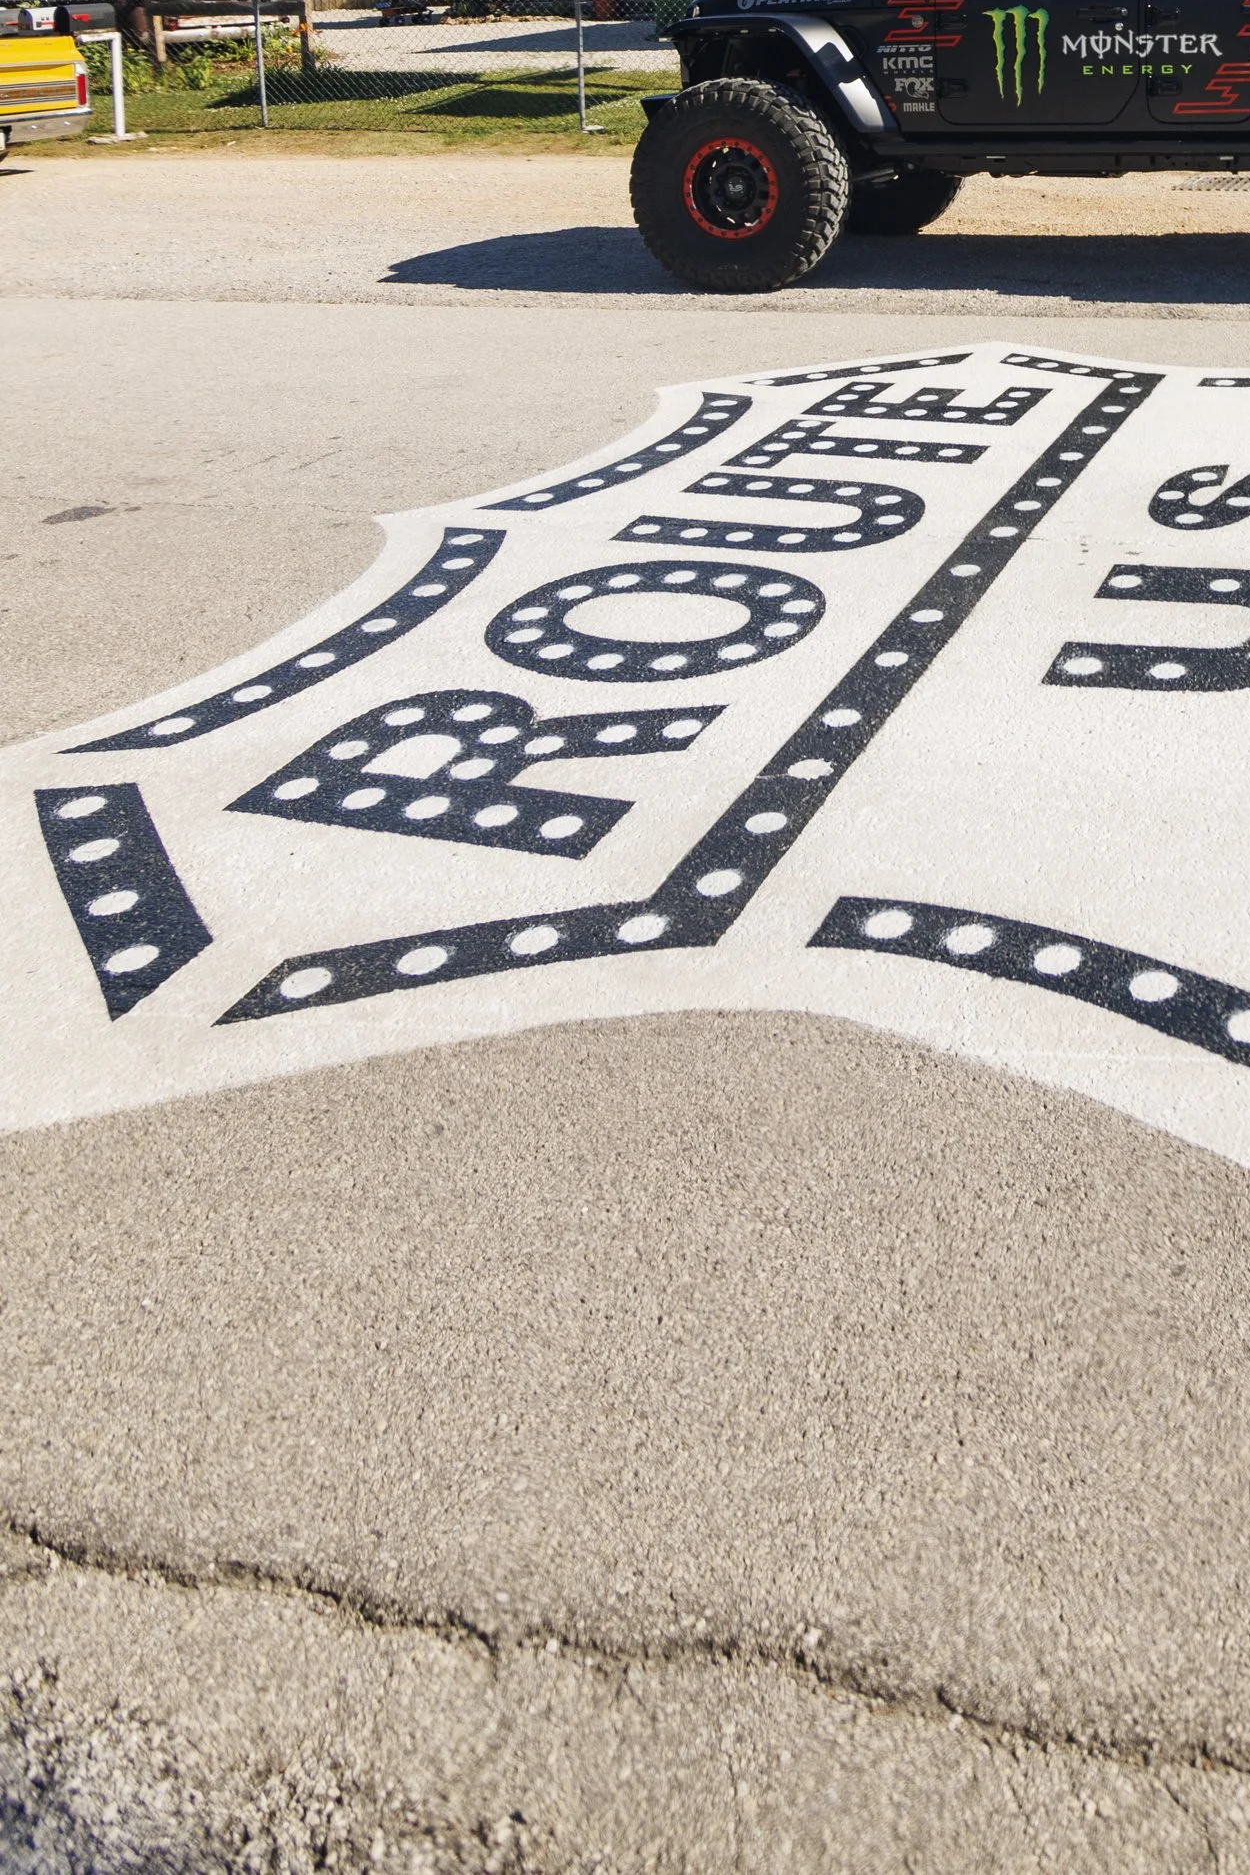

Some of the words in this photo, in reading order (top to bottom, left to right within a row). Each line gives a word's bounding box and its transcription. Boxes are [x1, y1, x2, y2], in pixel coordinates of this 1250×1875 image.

[877, 44, 932, 53] NITTO
[1061, 29, 1223, 60] MONSTER
[1082, 64, 1193, 76] ENERGY
[894, 77, 935, 94] FOX
[903, 102, 936, 113] MAHLE
[225, 382, 1050, 860] ROUTE
